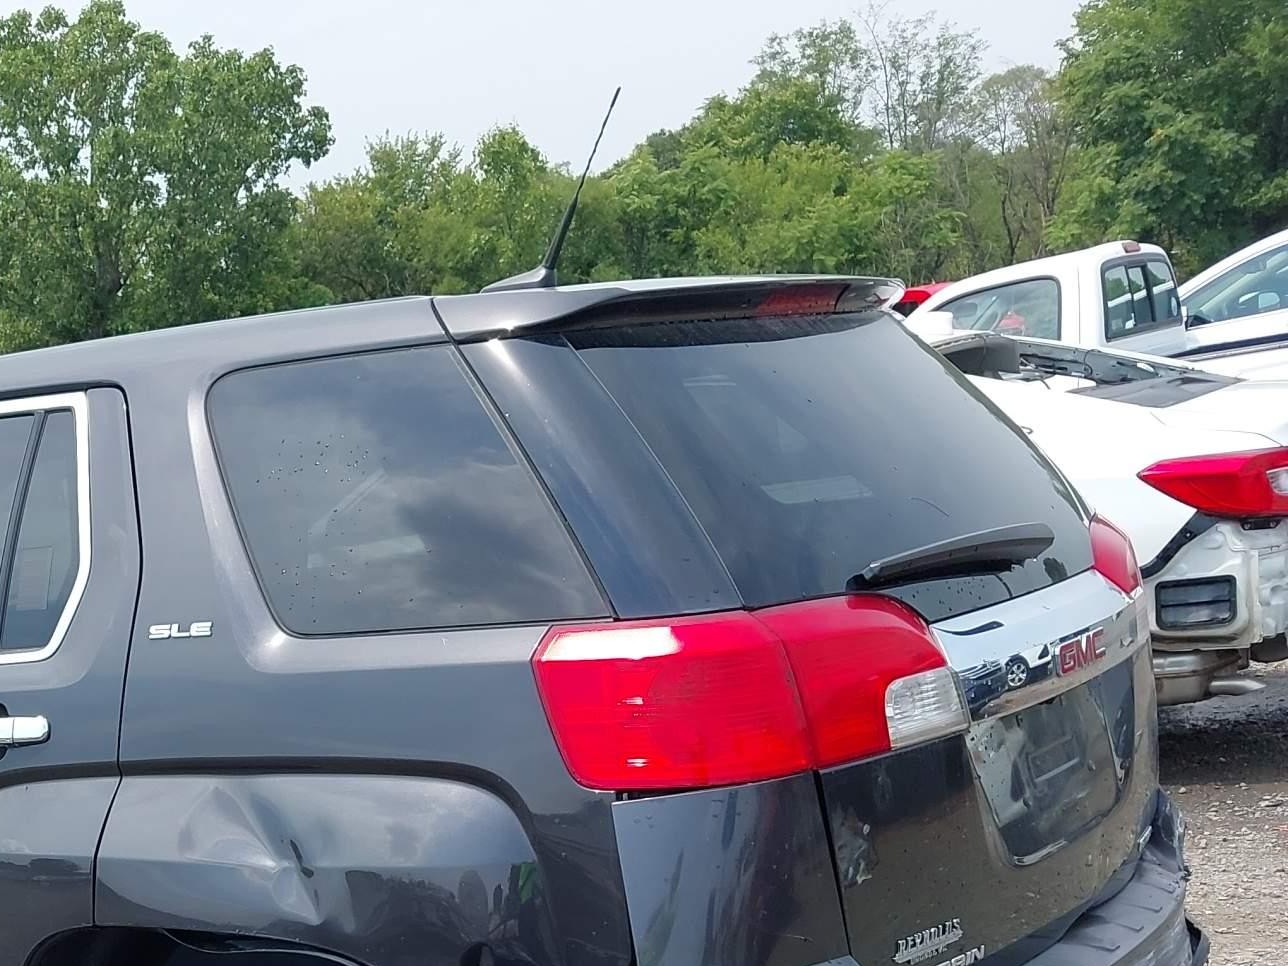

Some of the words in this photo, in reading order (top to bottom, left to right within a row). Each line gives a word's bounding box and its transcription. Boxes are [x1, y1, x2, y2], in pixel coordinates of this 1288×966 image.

[148, 621, 213, 640] SLE
[1059, 626, 1106, 676] GMC
[895, 918, 962, 957] REYNOLDS
